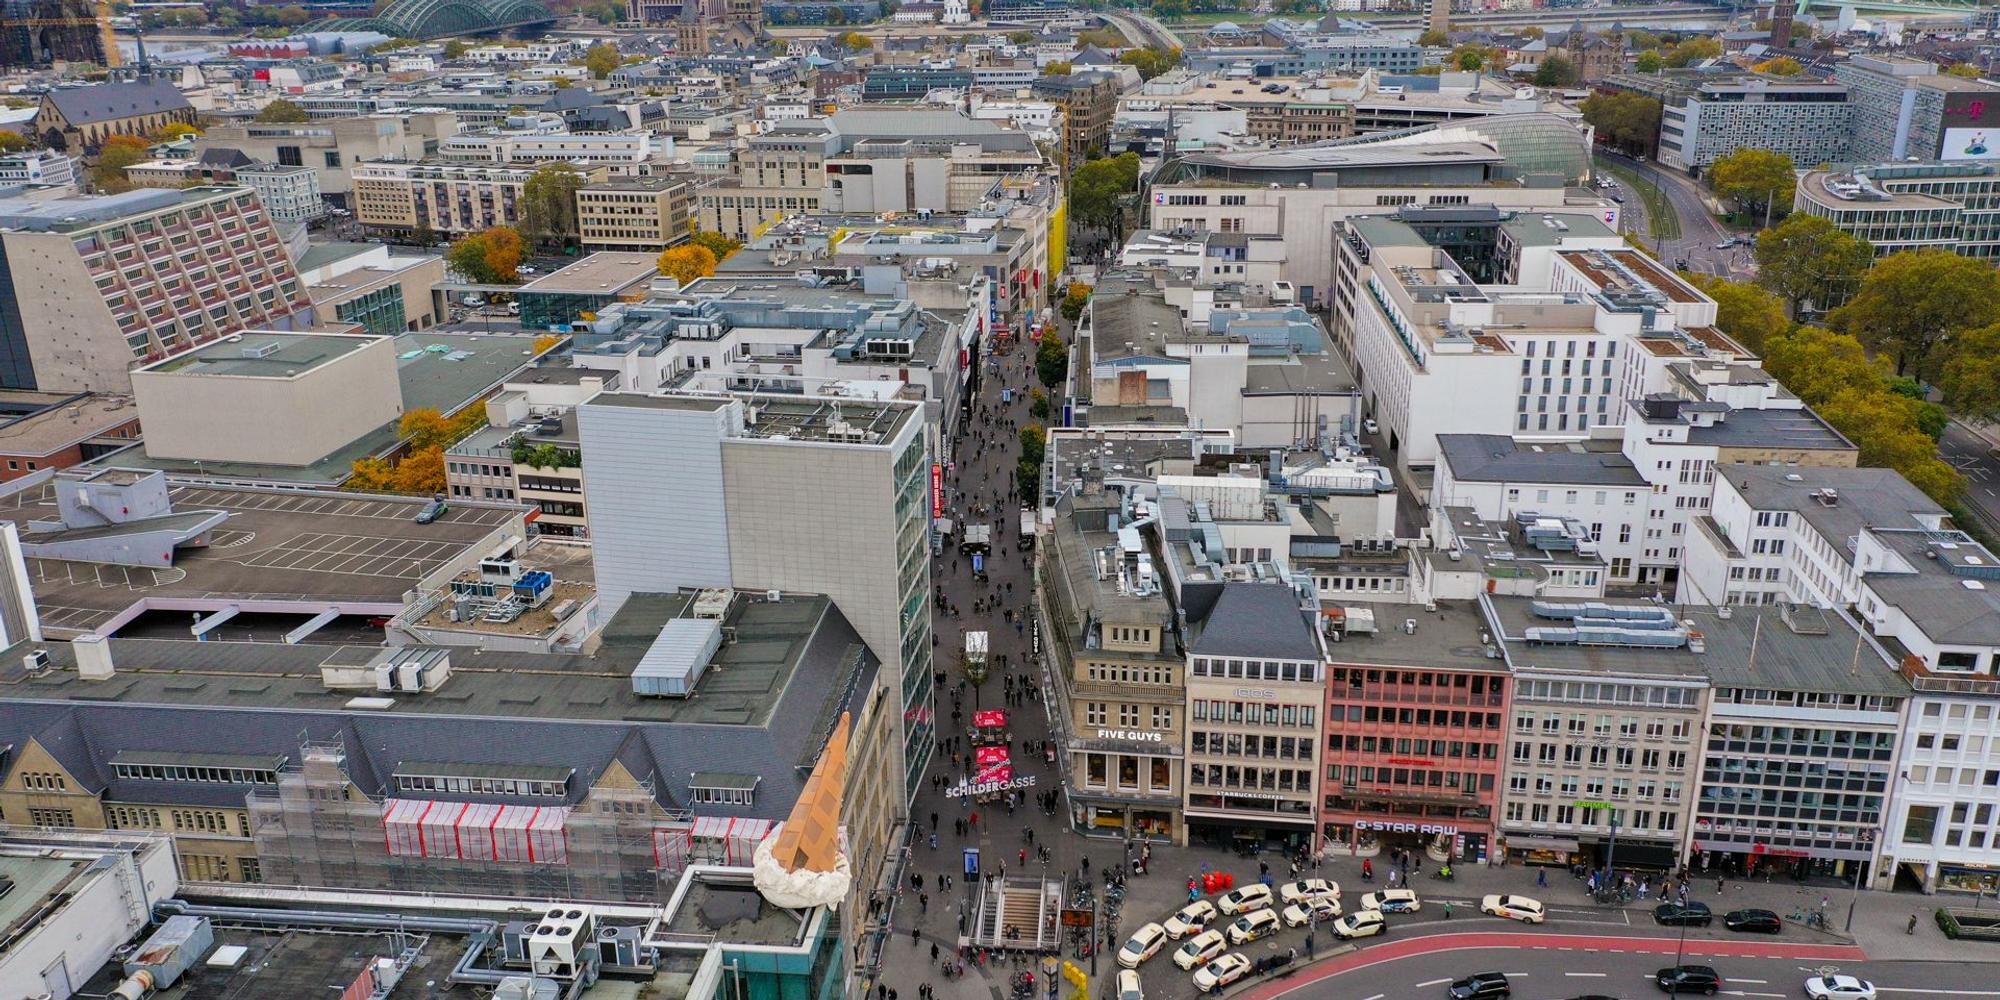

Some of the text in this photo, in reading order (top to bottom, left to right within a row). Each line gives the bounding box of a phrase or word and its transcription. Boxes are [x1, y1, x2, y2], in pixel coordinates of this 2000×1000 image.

[1098, 730, 1162, 742] FIVE GUYS
[945, 775, 1036, 798] SCHILDERGASSE
[1216, 790, 1257, 799] STARBUCKS
[1355, 820, 1458, 835] G-STAR RAW
